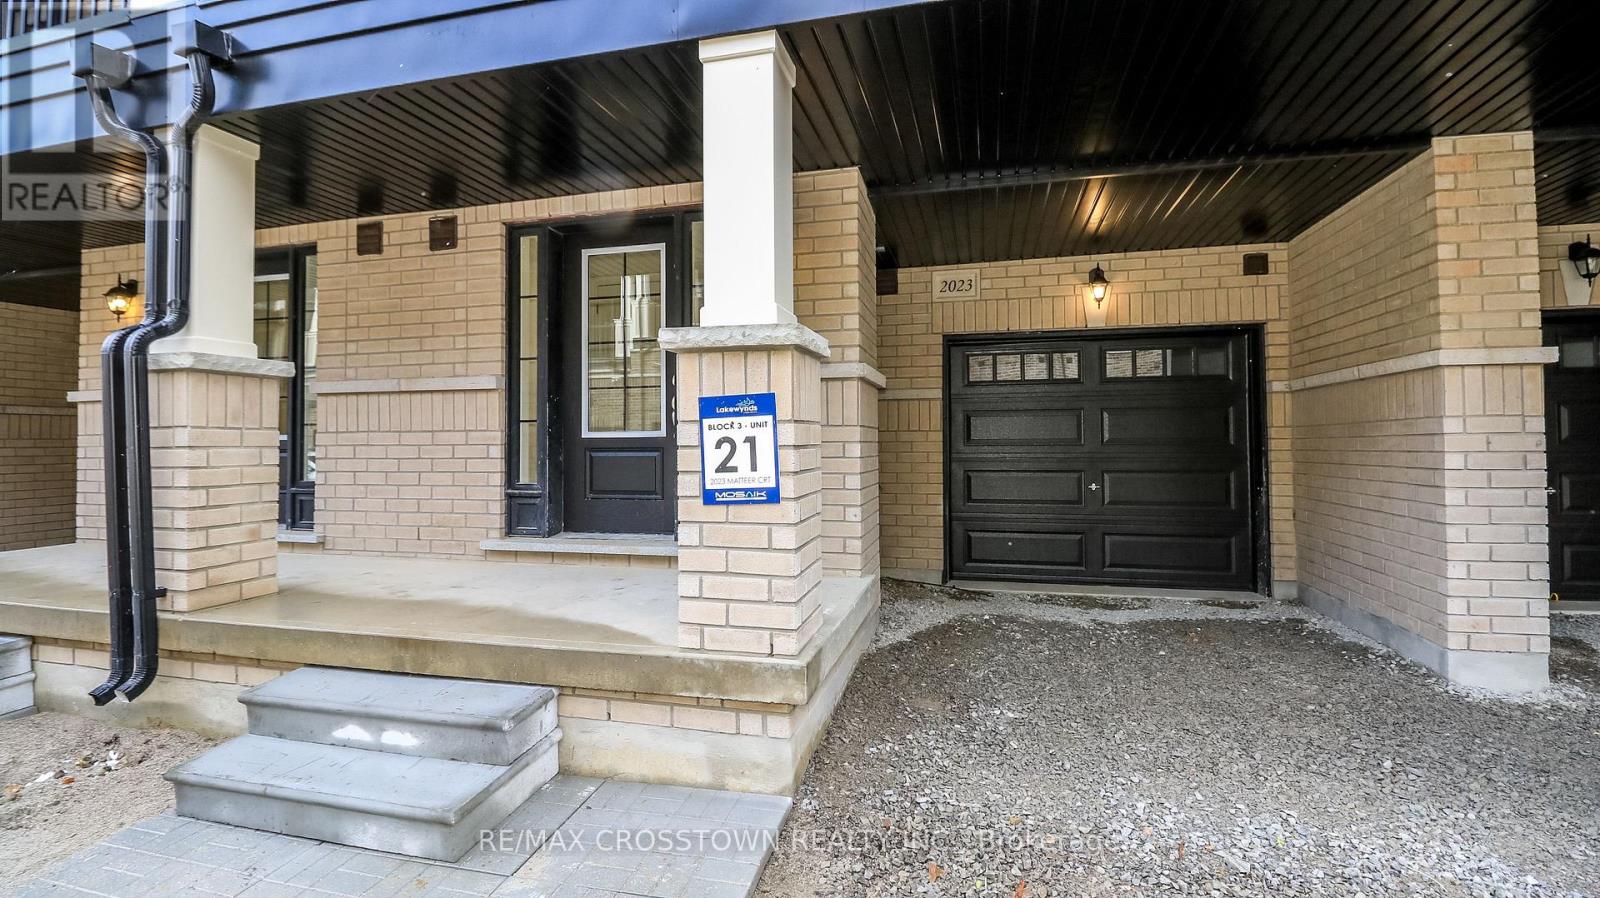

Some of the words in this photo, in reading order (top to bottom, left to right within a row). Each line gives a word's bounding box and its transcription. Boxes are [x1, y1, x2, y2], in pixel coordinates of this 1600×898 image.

[939, 279, 973, 293] 2023
[716, 405, 758, 413] Lakewynds
[708, 421, 735, 431] BLOCK
[737, 422, 743, 430] 3
[750, 420, 768, 429] UNIT
[714, 435, 758, 474] 21
[710, 477, 726, 486] 2023
[758, 475, 771, 484] CRT
[714, 490, 767, 499] MOSAIK
